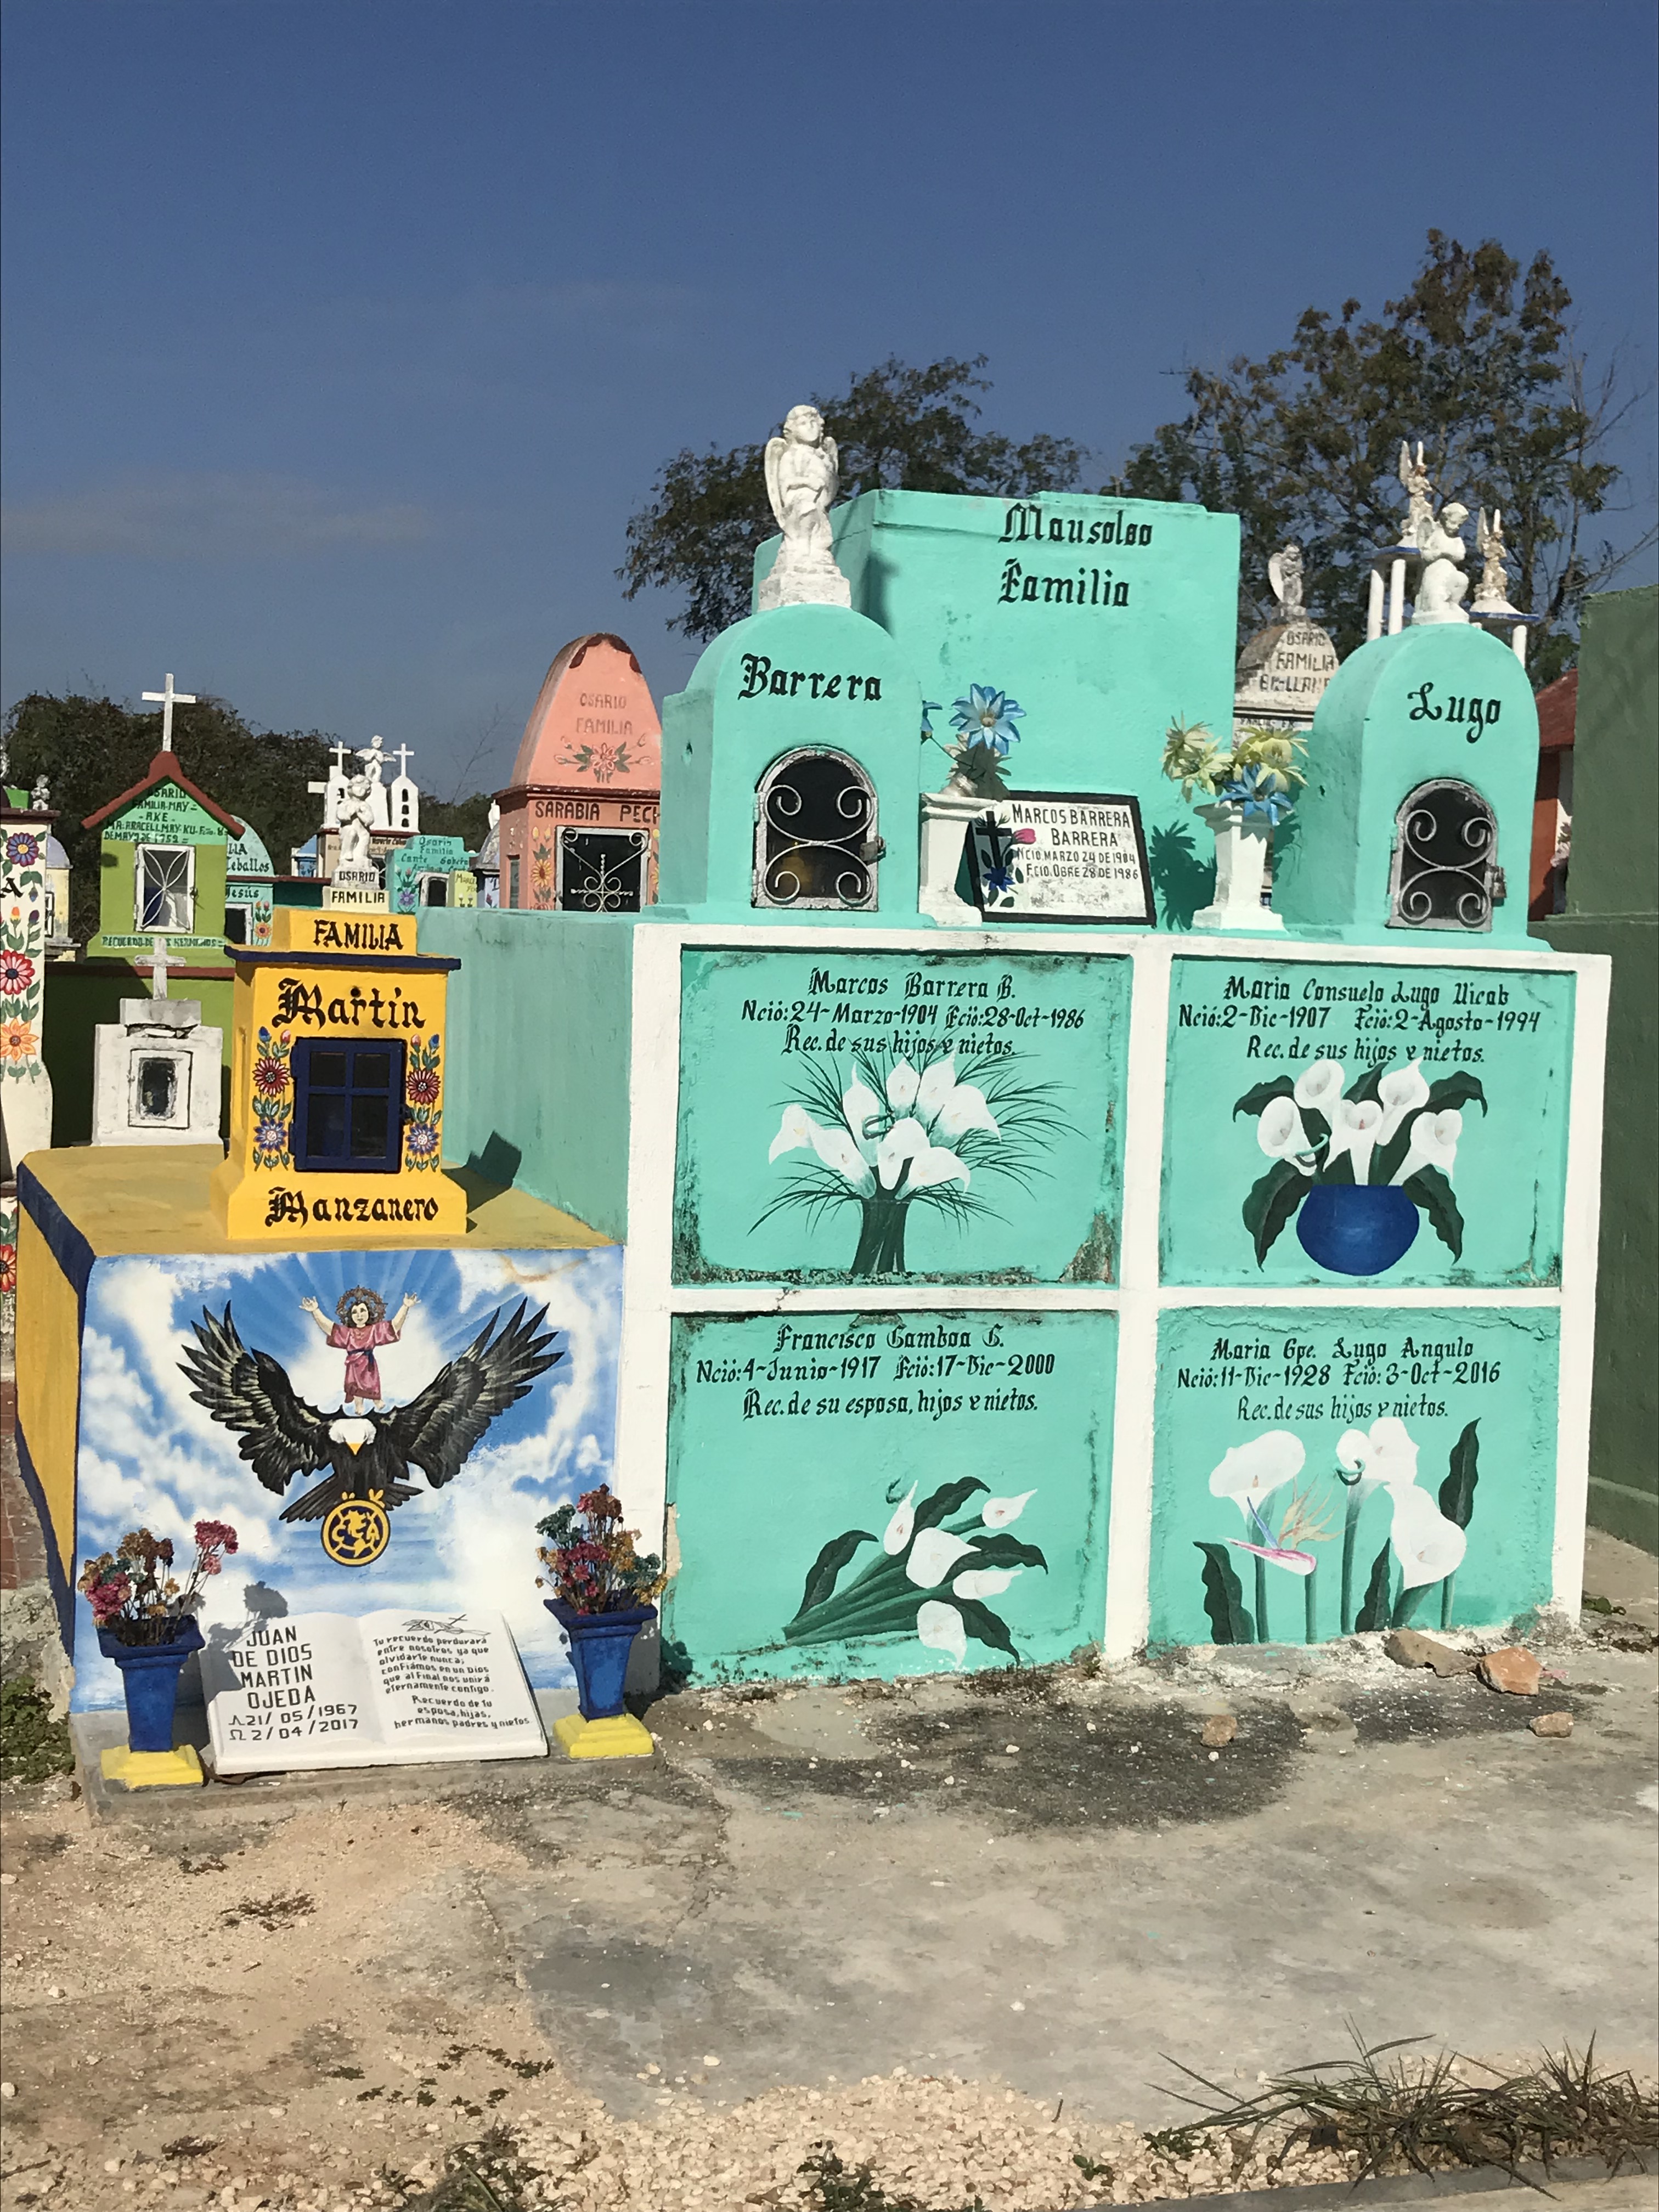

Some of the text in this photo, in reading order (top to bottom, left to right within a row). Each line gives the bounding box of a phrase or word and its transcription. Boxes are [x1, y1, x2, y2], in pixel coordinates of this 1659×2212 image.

[997, 558, 1129, 607] Familia
[1276, 652, 1335, 672] FAMILIA
[737, 653, 882, 701] Barrera
[580, 693, 627, 709] OSARIO
[1407, 682, 1501, 744] Lugo
[576, 718, 633, 735] FAMILIA
[535, 800, 600, 821] SARABIA
[1012, 804, 1130, 828] MARCOS BARRERA
[1051, 828, 1118, 847] BARRERA
[1082, 851, 1096, 864] 24
[1099, 853, 1110, 864] DE
[1113, 852, 1135, 865] 1904
[339, 871, 375, 882] OSARIO
[1082, 867, 1096, 879] 28
[1099, 867, 1111, 878] DE
[1114, 867, 1138, 880] 1986
[332, 891, 385, 903] FAMILIA
[313, 919, 404, 951] FAMILIA
[808, 967, 888, 995] Marcos
[904, 972, 989, 1000] Barrera
[1223, 975, 1290, 1000] Maria
[1303, 978, 1384, 1002] Consuelo
[1391, 981, 1440, 1012] Lugo
[272, 978, 426, 1031] Martín
[851, 1036, 887, 1053] sus
[893, 1029, 936, 1060] hijos
[1314, 1043, 1347, 1060] sus
[1354, 1037, 1397, 1068] hijos
[265, 1186, 439, 1228] Manzanero
[773, 1323, 876, 1353] Francisco
[887, 1324, 971, 1348] Gamboa
[1210, 1338, 1271, 1361] Maria
[1332, 1336, 1386, 1366] Lugo
[1401, 1336, 1474, 1362] Angulo
[816, 1397, 841, 1415] su
[918, 1389, 963, 1421] hijos
[1295, 1402, 1323, 1420] sus
[1330, 1394, 1372, 1424] hijos
[247, 1626, 297, 1646] JUAN
[387, 1635, 433, 1644] recuerdo
[232, 1643, 312, 1667] DE DIOS
[377, 1645, 489, 1656] entre nosotros ya que
[379, 1653, 427, 1666] olvidarte
[240, 1664, 313, 1688] MARTIN
[383, 1674, 400, 1686] que
[405, 1672, 414, 1680] al
[443, 1675, 460, 1683] nos
[247, 1685, 316, 1709] OJEDA
[385, 1683, 449, 1695] eternamente
[411, 1695, 466, 1707] Recuerdo
[394, 1717, 449, 1729] hermanos
[453, 1719, 488, 1728] padres
[492, 1721, 498, 1729] y
